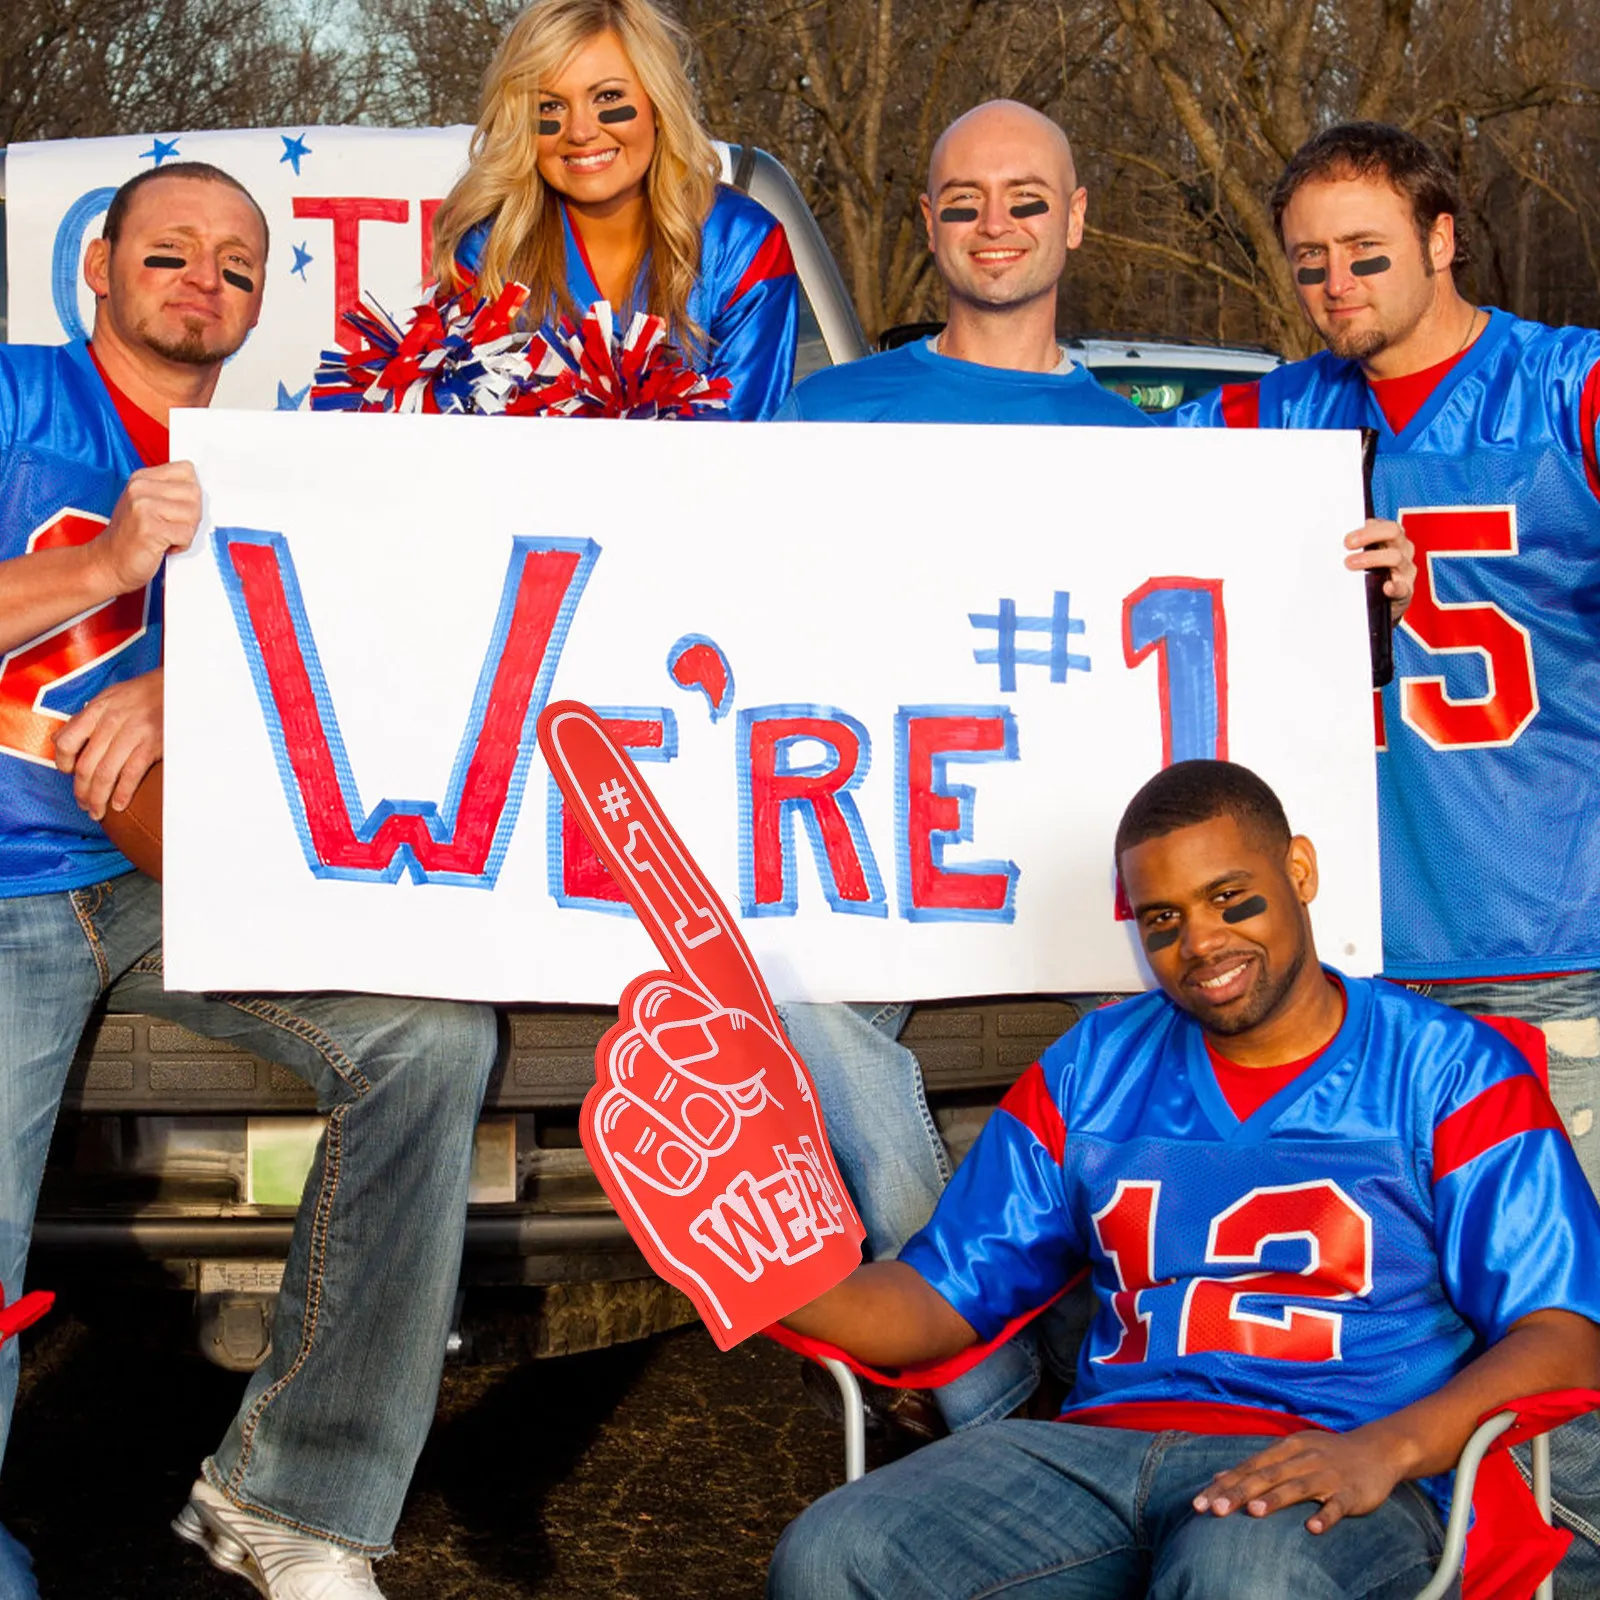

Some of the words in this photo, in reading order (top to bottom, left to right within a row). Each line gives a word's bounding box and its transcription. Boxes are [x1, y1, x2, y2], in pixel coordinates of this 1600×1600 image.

[1373, 504, 1541, 752] 5
[597, 777, 723, 950] #1
[1091, 1178, 1374, 1364] 12
